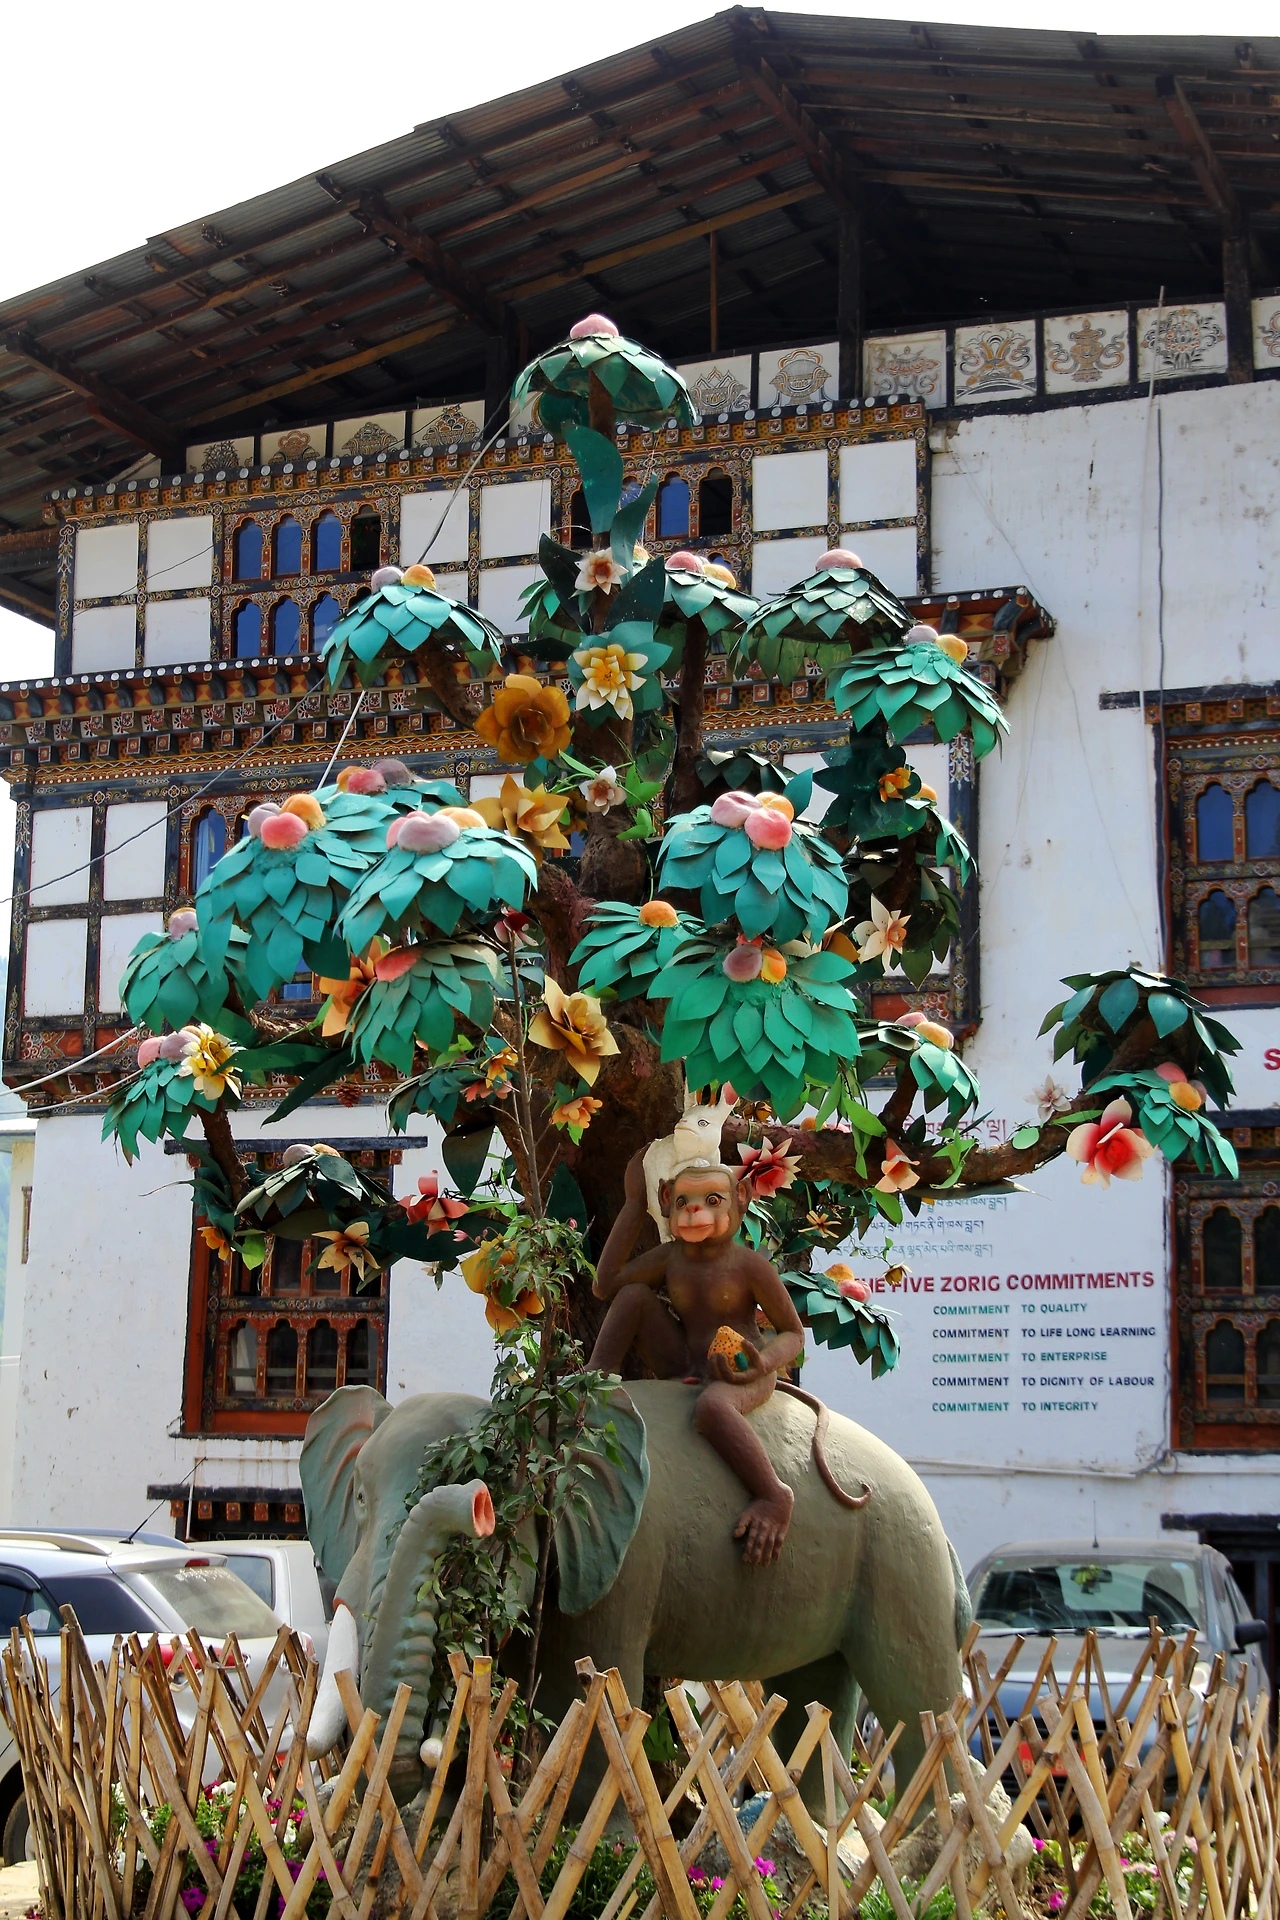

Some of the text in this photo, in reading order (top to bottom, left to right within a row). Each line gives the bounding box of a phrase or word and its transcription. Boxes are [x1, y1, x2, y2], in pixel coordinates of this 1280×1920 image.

[940, 1274, 1000, 1292] ZORIG
[1005, 1271, 1154, 1291] COMMITMENTS
[933, 1303, 1088, 1315] COMMITMENT TO QUALITY
[932, 1326, 1156, 1338] COMMITMENT TO LIFE LONG LEARNING
[932, 1351, 1107, 1363] COMMITMENT TO ENTERPRISE
[932, 1376, 1155, 1386] COMMITMENT TO DIGNITY OF LABOUR
[932, 1401, 1098, 1412] COMMITMENT TO INTEGRITY
